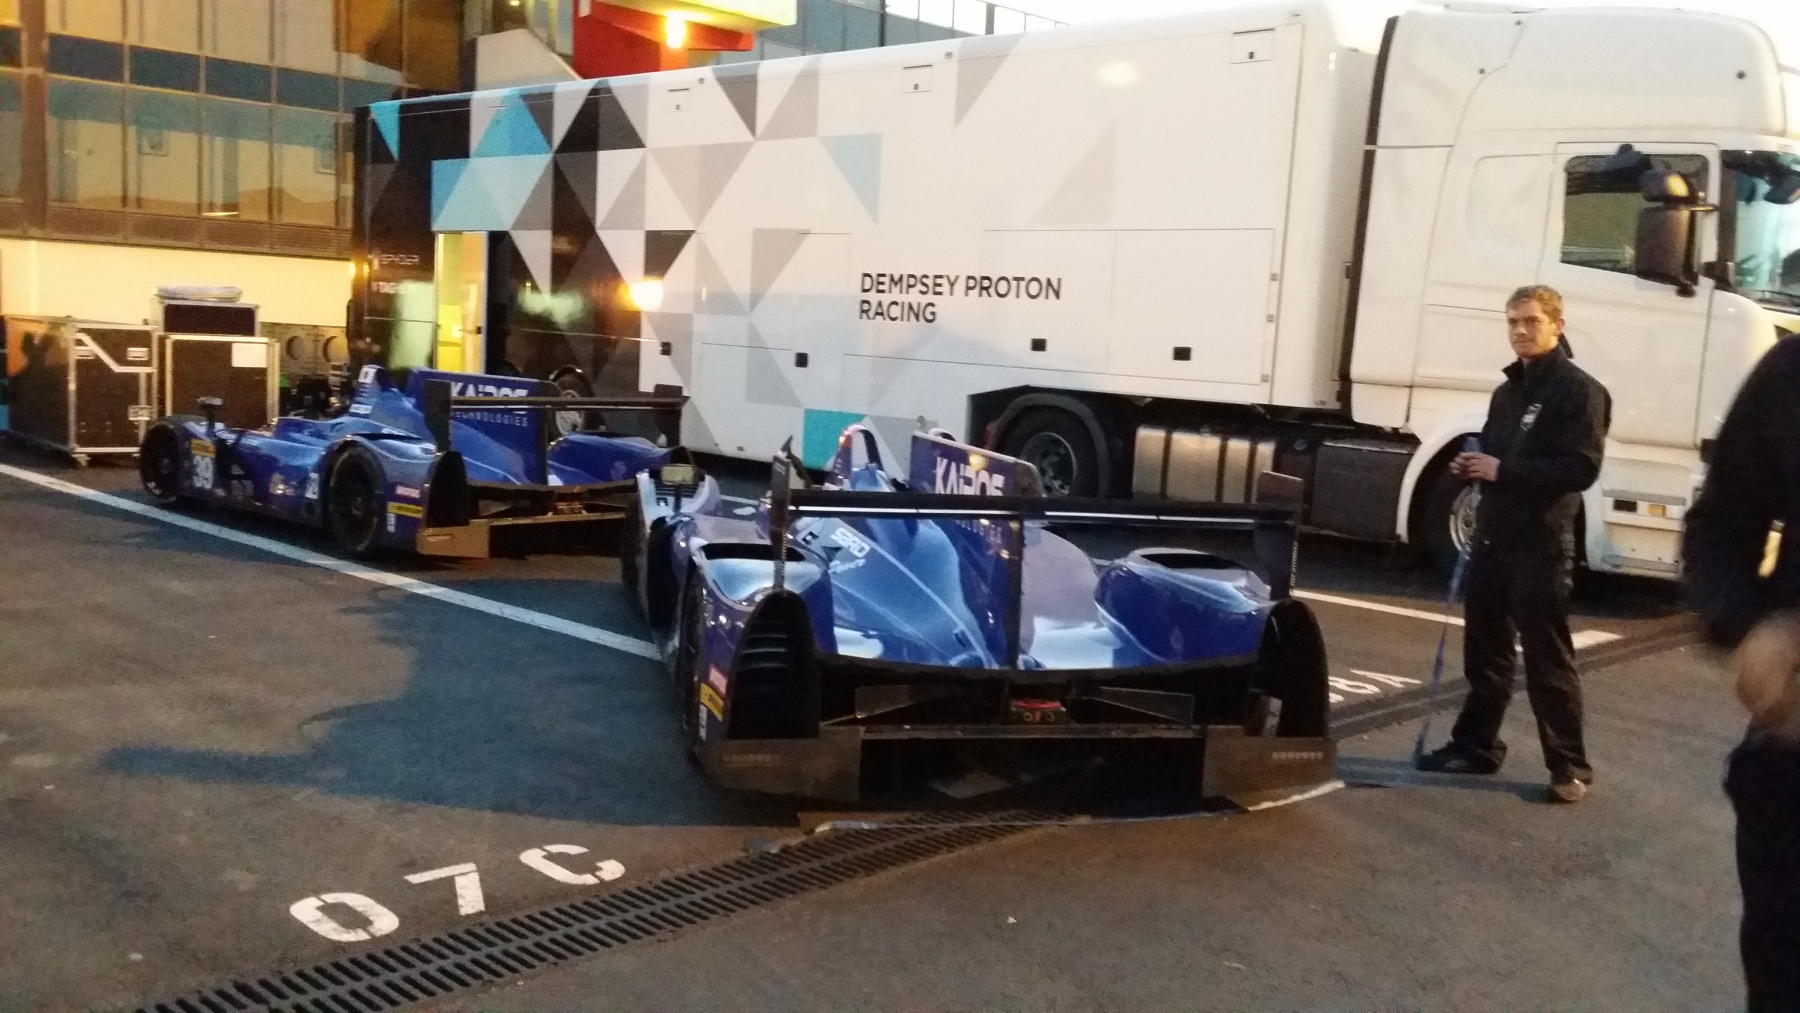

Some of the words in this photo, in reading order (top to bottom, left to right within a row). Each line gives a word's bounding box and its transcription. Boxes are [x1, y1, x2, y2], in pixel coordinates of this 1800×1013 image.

[861, 272, 959, 296] DEMPSEY
[964, 275, 1062, 300] PROTON
[859, 299, 936, 323] RACING
